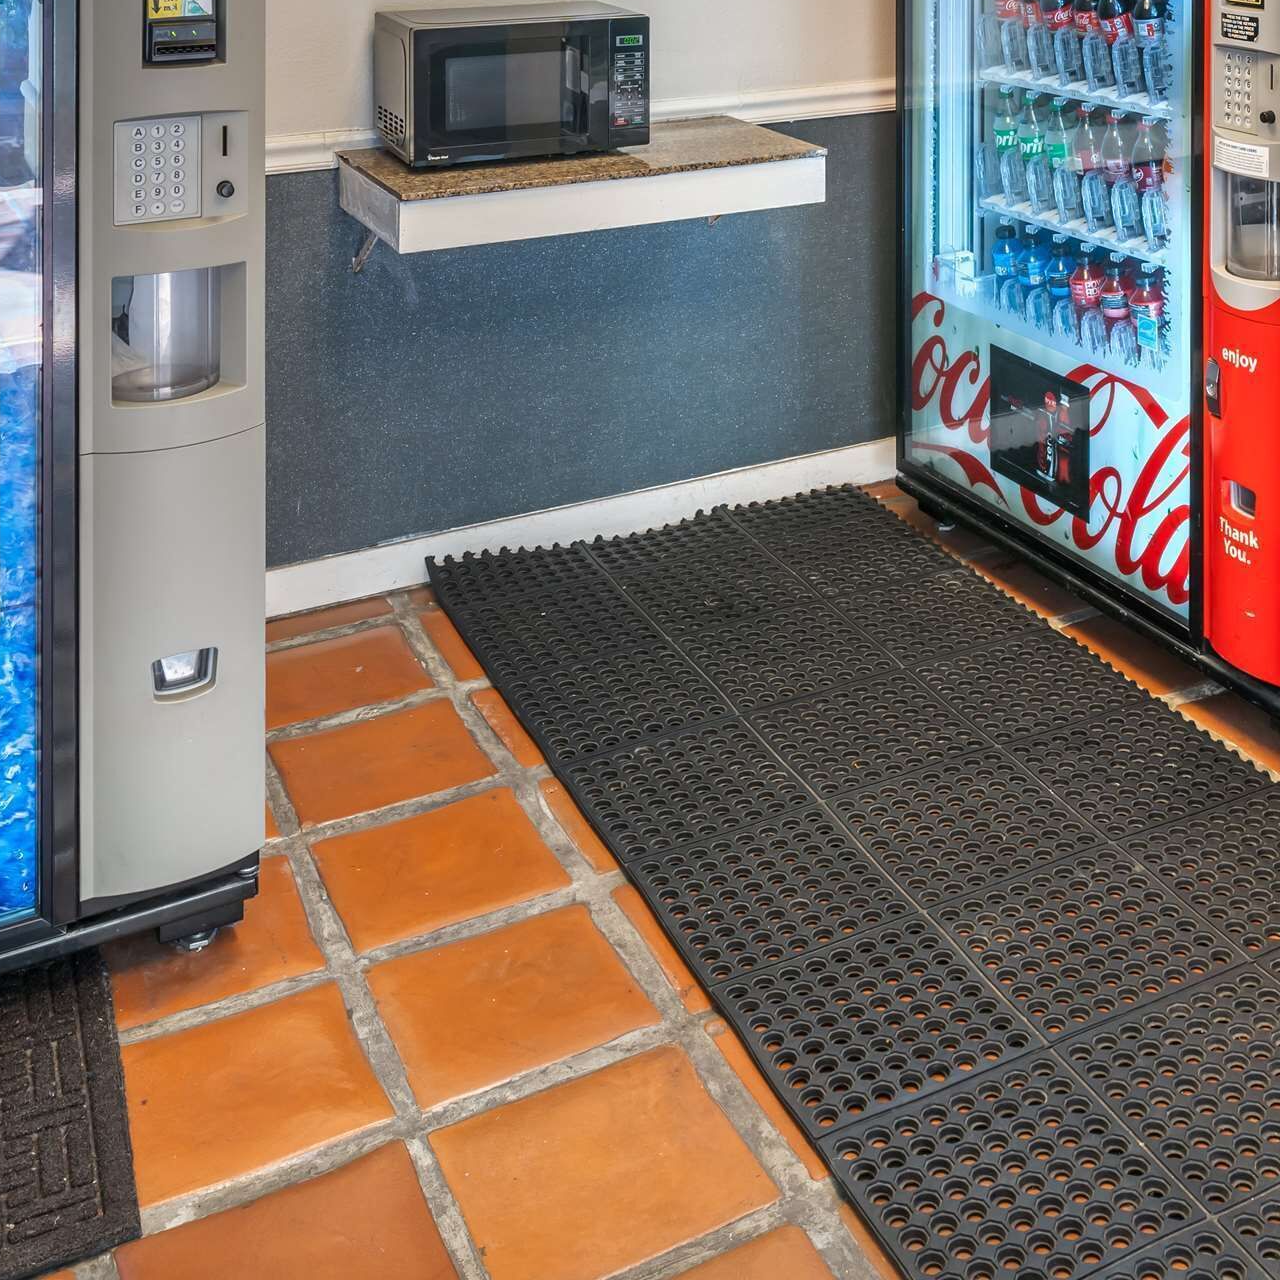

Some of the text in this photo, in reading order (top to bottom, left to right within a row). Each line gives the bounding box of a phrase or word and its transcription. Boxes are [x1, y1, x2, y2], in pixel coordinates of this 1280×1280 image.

[134, 128, 143, 136] A
[174, 125, 180, 133] 2
[135, 144, 142, 152] B
[134, 159, 142, 168] C
[135, 175, 142, 183] D
[135, 190, 142, 198] E
[174, 186, 180, 194] 0
[1222, 347, 1258, 373] enjoy
[1220, 516, 1259, 550] Thank
[1222, 540, 1251, 565] You.
